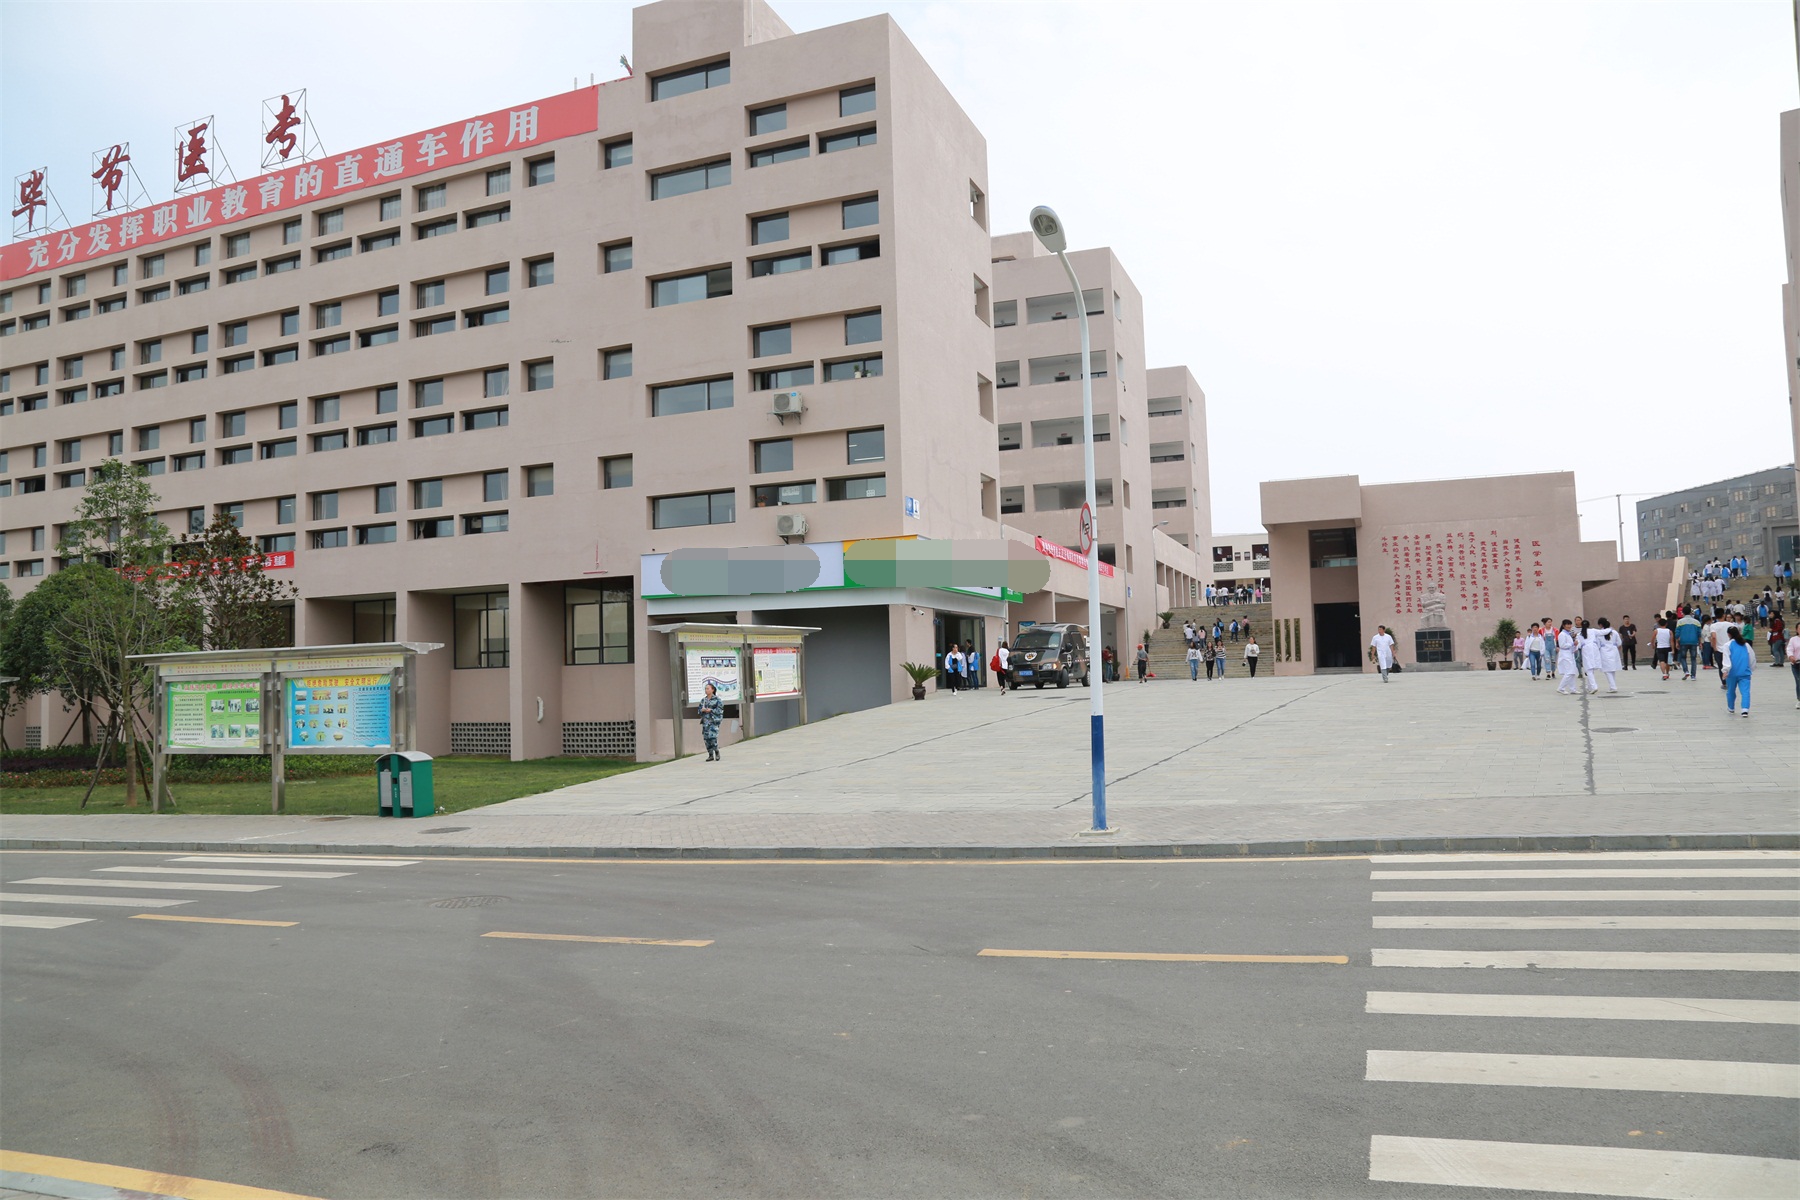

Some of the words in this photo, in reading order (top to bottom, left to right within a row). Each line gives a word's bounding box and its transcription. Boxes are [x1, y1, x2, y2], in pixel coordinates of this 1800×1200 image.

[12, 94, 303, 232] 毕节医专
[26, 105, 540, 271] 充分发挥职业教育的直通车作用
[1531, 540, 1544, 587] 医学生誓言
